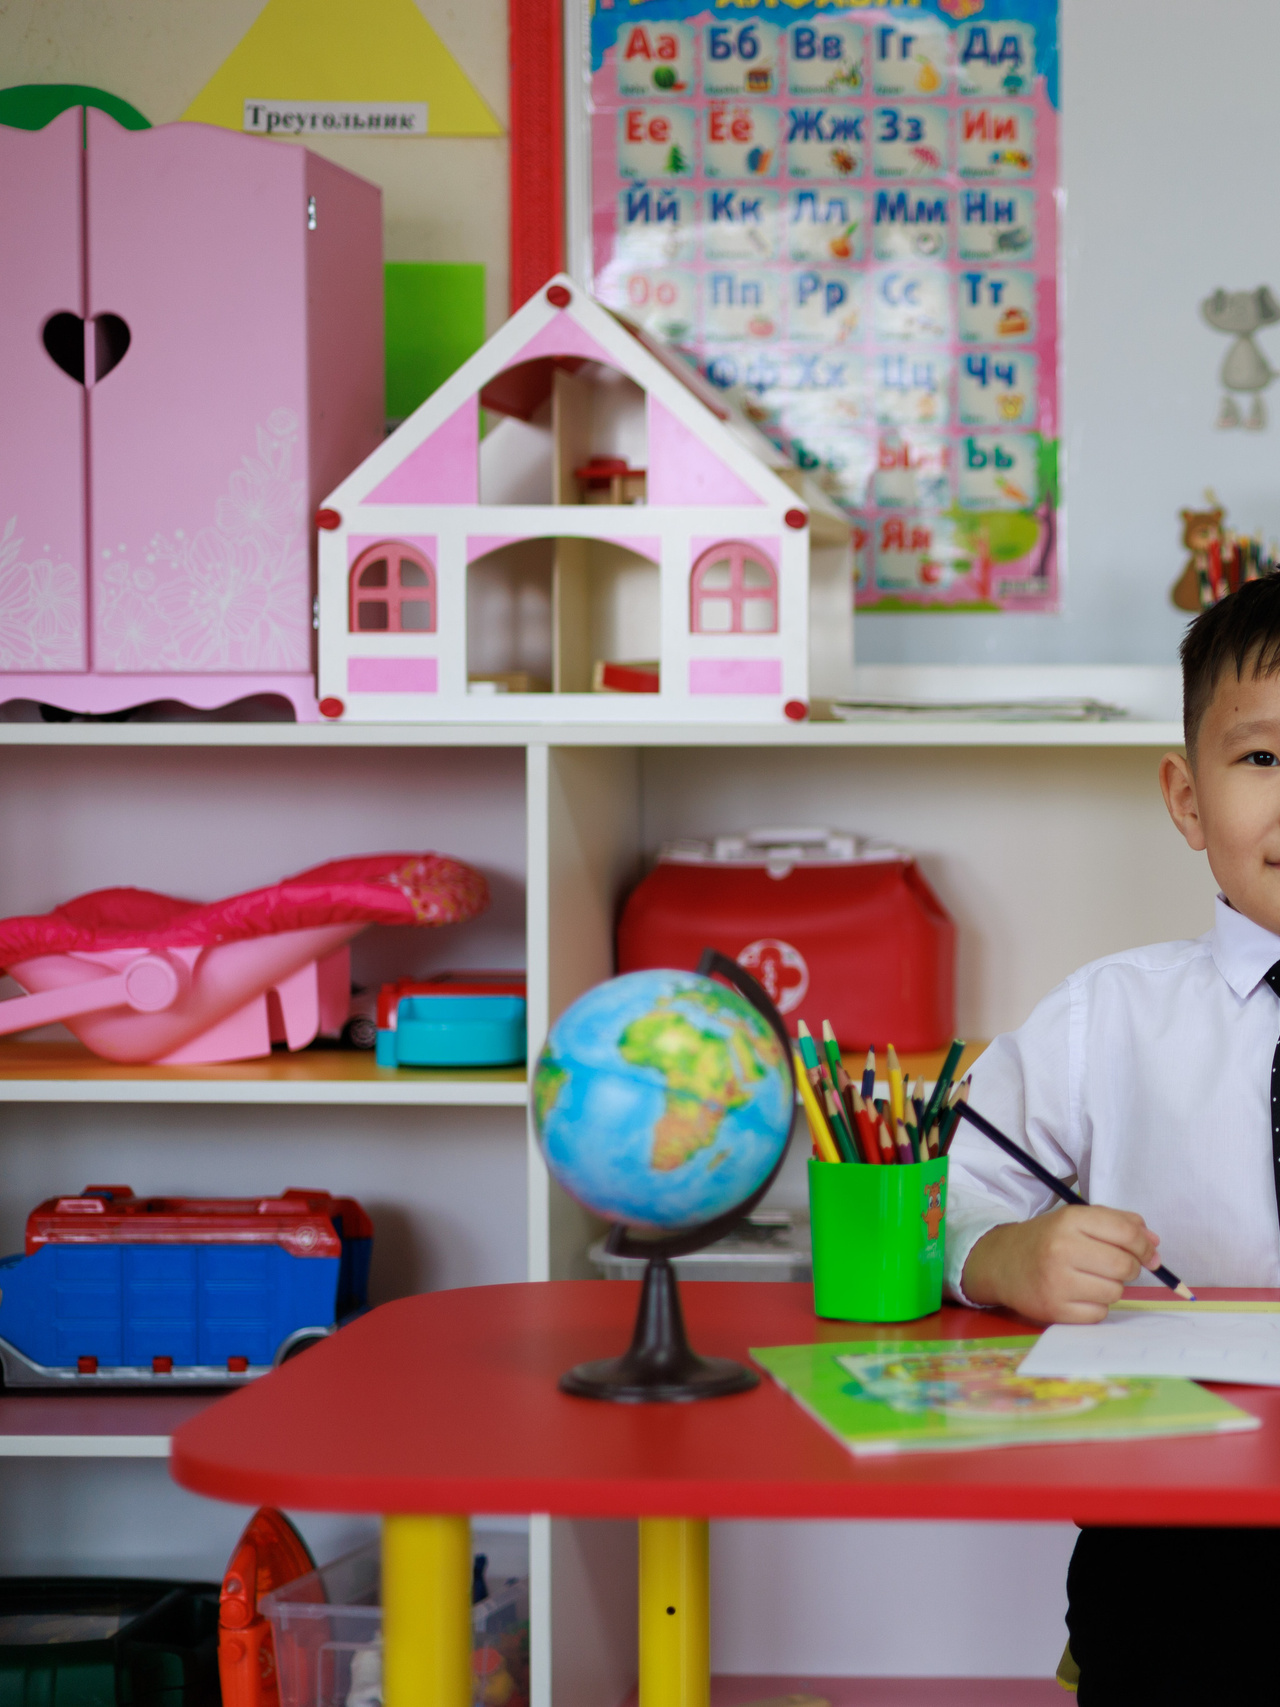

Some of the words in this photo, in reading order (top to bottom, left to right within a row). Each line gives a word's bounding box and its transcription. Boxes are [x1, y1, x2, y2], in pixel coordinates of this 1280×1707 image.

[625, 26, 679, 61] Аа
[708, 25, 760, 60] Бб
[795, 27, 843, 60] Вв
[879, 26, 917, 60] Гг
[962, 26, 1024, 65] Дд
[247, 104, 416, 135] Треугольник
[627, 109, 669, 142] Ее
[709, 100, 751, 142] Ёё
[787, 109, 864, 142] Жж
[879, 108, 924, 142] Зз
[963, 108, 1017, 142] Ии
[625, 181, 680, 223] Йй
[710, 193, 762, 223] Кк
[789, 194, 848, 224] Лл
[875, 193, 947, 224] Мм
[964, 193, 1015, 224] Нн
[627, 275, 678, 306] Оо
[710, 275, 762, 306] Пп
[796, 274, 847, 316] Рр
[883, 274, 920, 306] Сс
[965, 273, 1004, 305] Тт
[882, 355, 937, 391] Цц
[967, 356, 1015, 387] Чч
[882, 519, 931, 551] Яя
